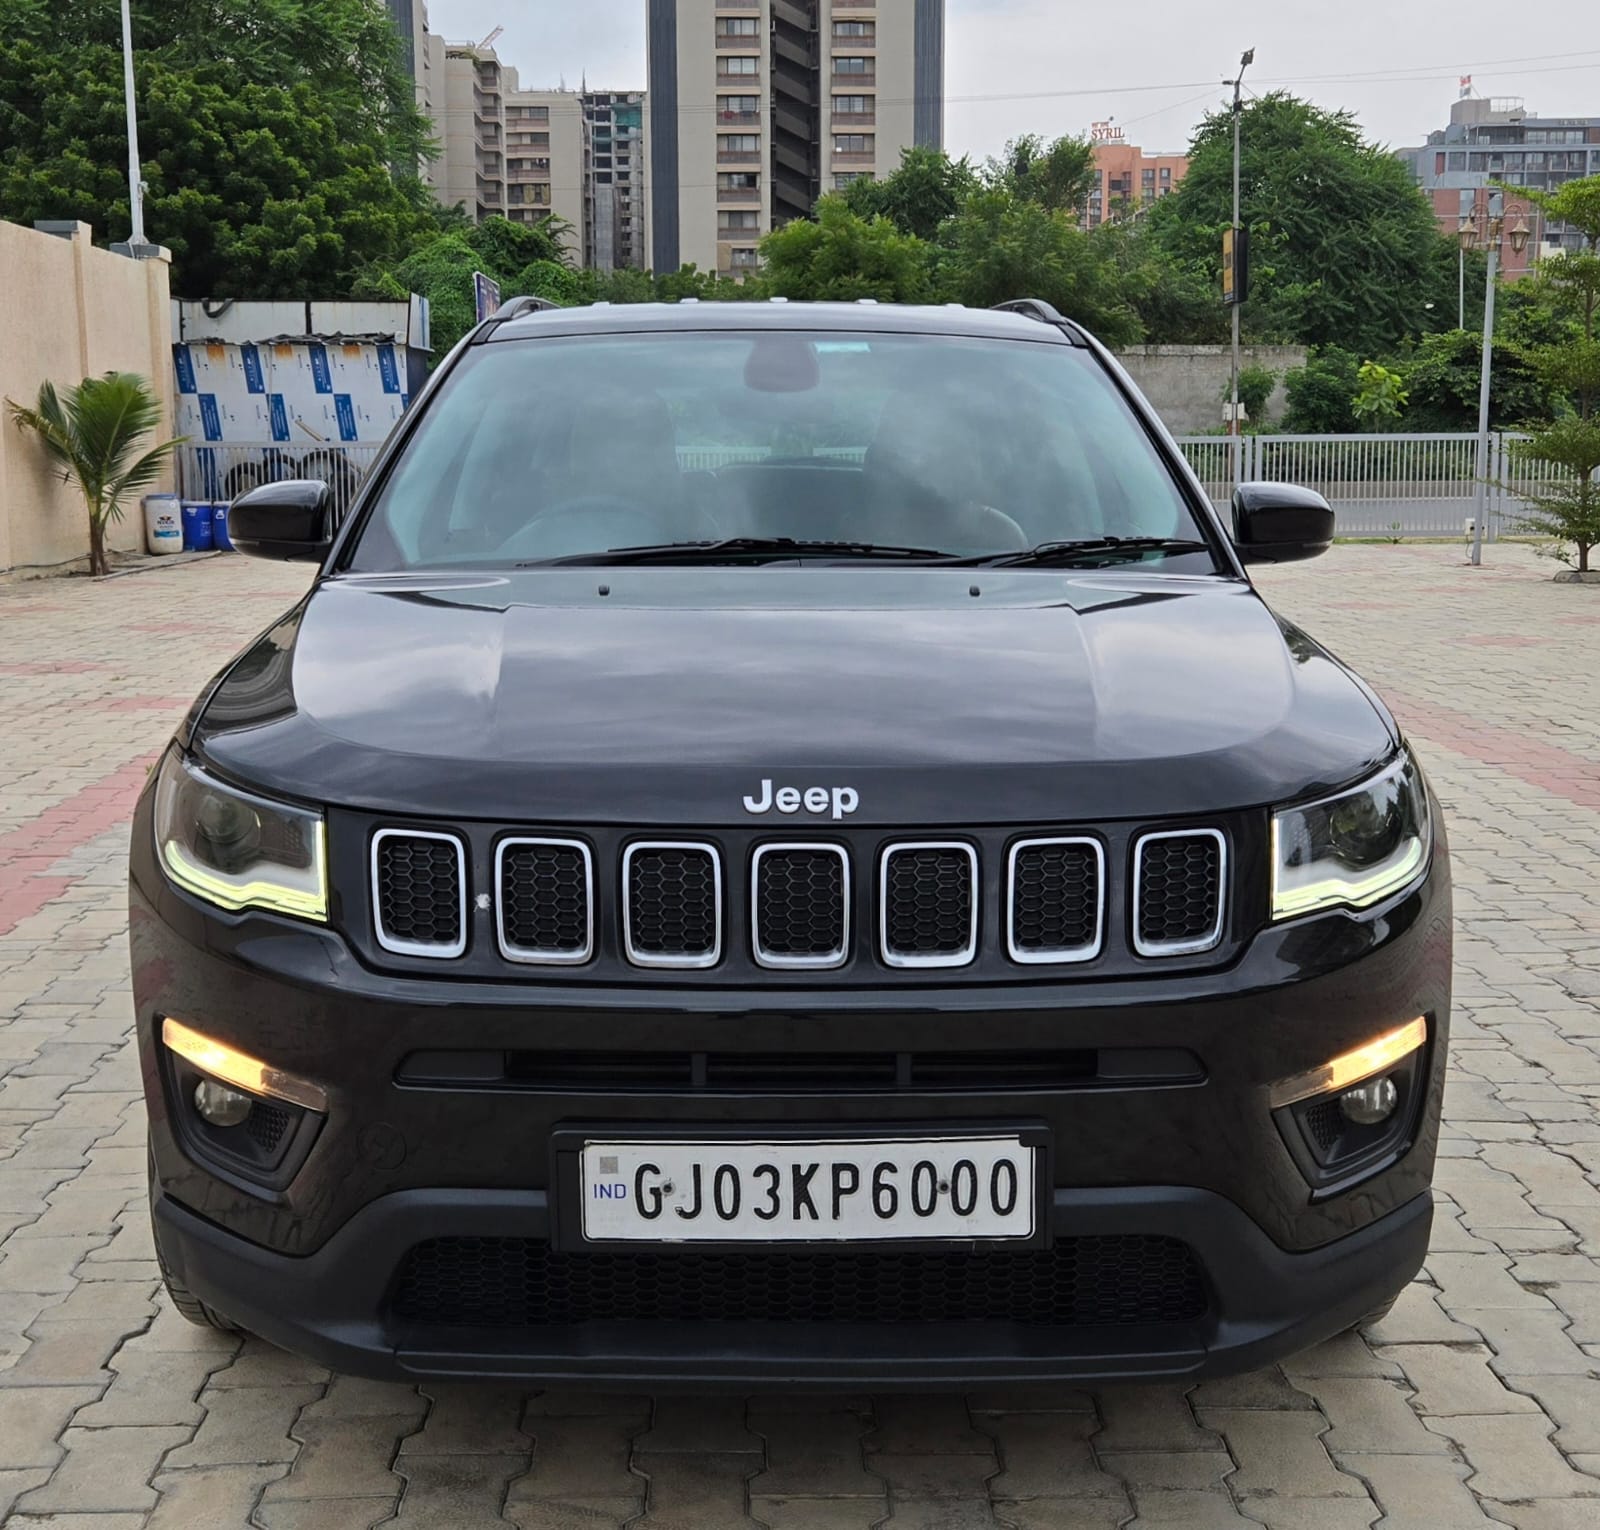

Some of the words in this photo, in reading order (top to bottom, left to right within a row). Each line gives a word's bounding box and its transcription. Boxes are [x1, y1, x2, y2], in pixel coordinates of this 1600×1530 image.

[1091, 127, 1125, 140] SYRIL
[743, 779, 859, 819] Jeep
[594, 1184, 626, 1199] IND
[634, 1158, 1018, 1220] GJ03KP6000
